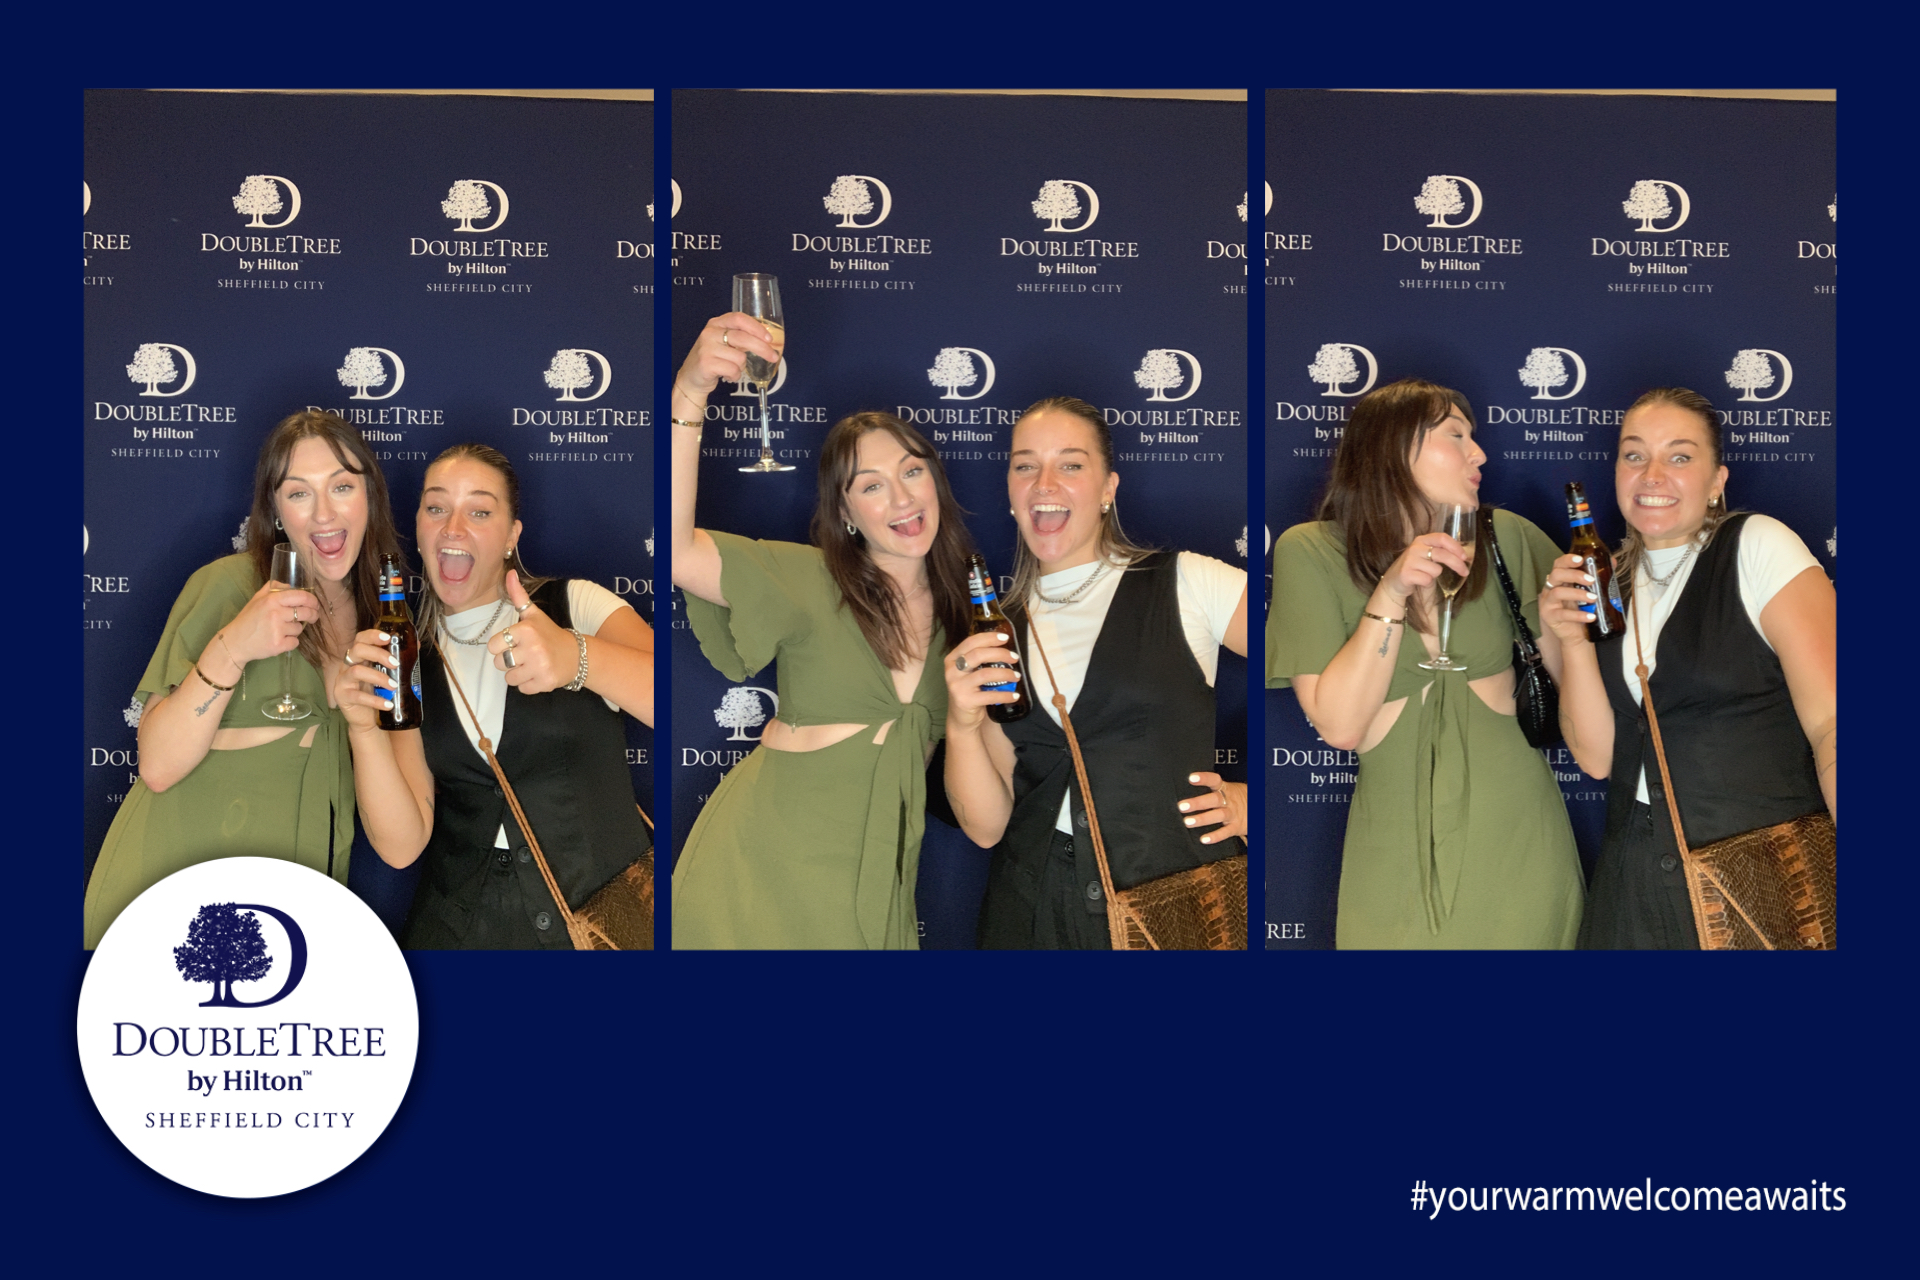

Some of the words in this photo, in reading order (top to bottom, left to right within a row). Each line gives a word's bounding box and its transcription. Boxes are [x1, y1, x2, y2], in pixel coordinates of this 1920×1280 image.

[201, 233, 341, 254] DOUBLETREE
[410, 237, 548, 257] DOUBLETREE
[791, 233, 931, 254] DOUBLETREE
[1000, 237, 1138, 257] DOUBLETREE
[1382, 233, 1522, 254] DOUBLETREE
[1591, 237, 1729, 257] DOUBLETREE
[239, 257, 254, 272] by
[448, 261, 463, 276] by
[830, 257, 845, 272] by
[1038, 262, 1053, 276] by
[1421, 257, 1436, 272] by
[1629, 262, 1644, 276] by
[83, 276, 113, 285] CITY
[217, 278, 288, 289] SHEFFIELD
[293, 280, 324, 289] CITY
[426, 283, 496, 292] SHEFFIELD
[501, 283, 532, 292] CITY
[673, 276, 704, 285] CITY
[808, 279, 879, 289] SHEFFIELD
[883, 280, 915, 289] CITY
[1016, 283, 1086, 292] SHEFFIELD
[1091, 284, 1122, 292] CITY
[1264, 276, 1295, 285] CITY
[1399, 279, 1470, 289] SHEFFIELD
[1474, 280, 1505, 290] CITY
[1607, 283, 1677, 292] SHEFFIELD
[1682, 284, 1713, 292] CITY
[94, 401, 236, 422] DOUBLETREE
[512, 407, 650, 426] DOUBLETREE
[896, 405, 1026, 425] DOUBLETRE
[1103, 408, 1241, 427] DOUBLETREE
[1715, 408, 1832, 427] OUBLETREE
[133, 426, 149, 441] by
[549, 431, 565, 445] by
[724, 427, 741, 441] by
[742, 427, 785, 440] Hilon
[934, 429, 949, 444] by
[1140, 431, 1155, 445] by
[1315, 426, 1331, 442] by
[1524, 429, 1540, 444] by
[1731, 431, 1746, 445] by
[111, 448, 183, 457] SHEFFIELD
[188, 449, 219, 458] CITY
[397, 451, 427, 460] CITY
[528, 452, 597, 461] SHEFFIELD
[603, 452, 633, 461] CITY
[779, 449, 810, 458] CITY
[938, 450, 983, 460] FFIELD
[987, 451, 1011, 461] CIT
[1119, 452, 1188, 461] SHEFFIELD
[1193, 452, 1224, 461] CITY
[1503, 450, 1573, 460] SHEFFIELD
[1578, 451, 1608, 460] CITY
[1722, 452, 1780, 462] EFFIELD
[1784, 452, 1814, 461] CITY
[1272, 747, 1359, 767] DOUBLE
[1310, 772, 1327, 787] by
[1329, 772, 1358, 784] Hilt
[1288, 794, 1350, 803] SHEFFIEL
[1575, 791, 1607, 801] CITY
